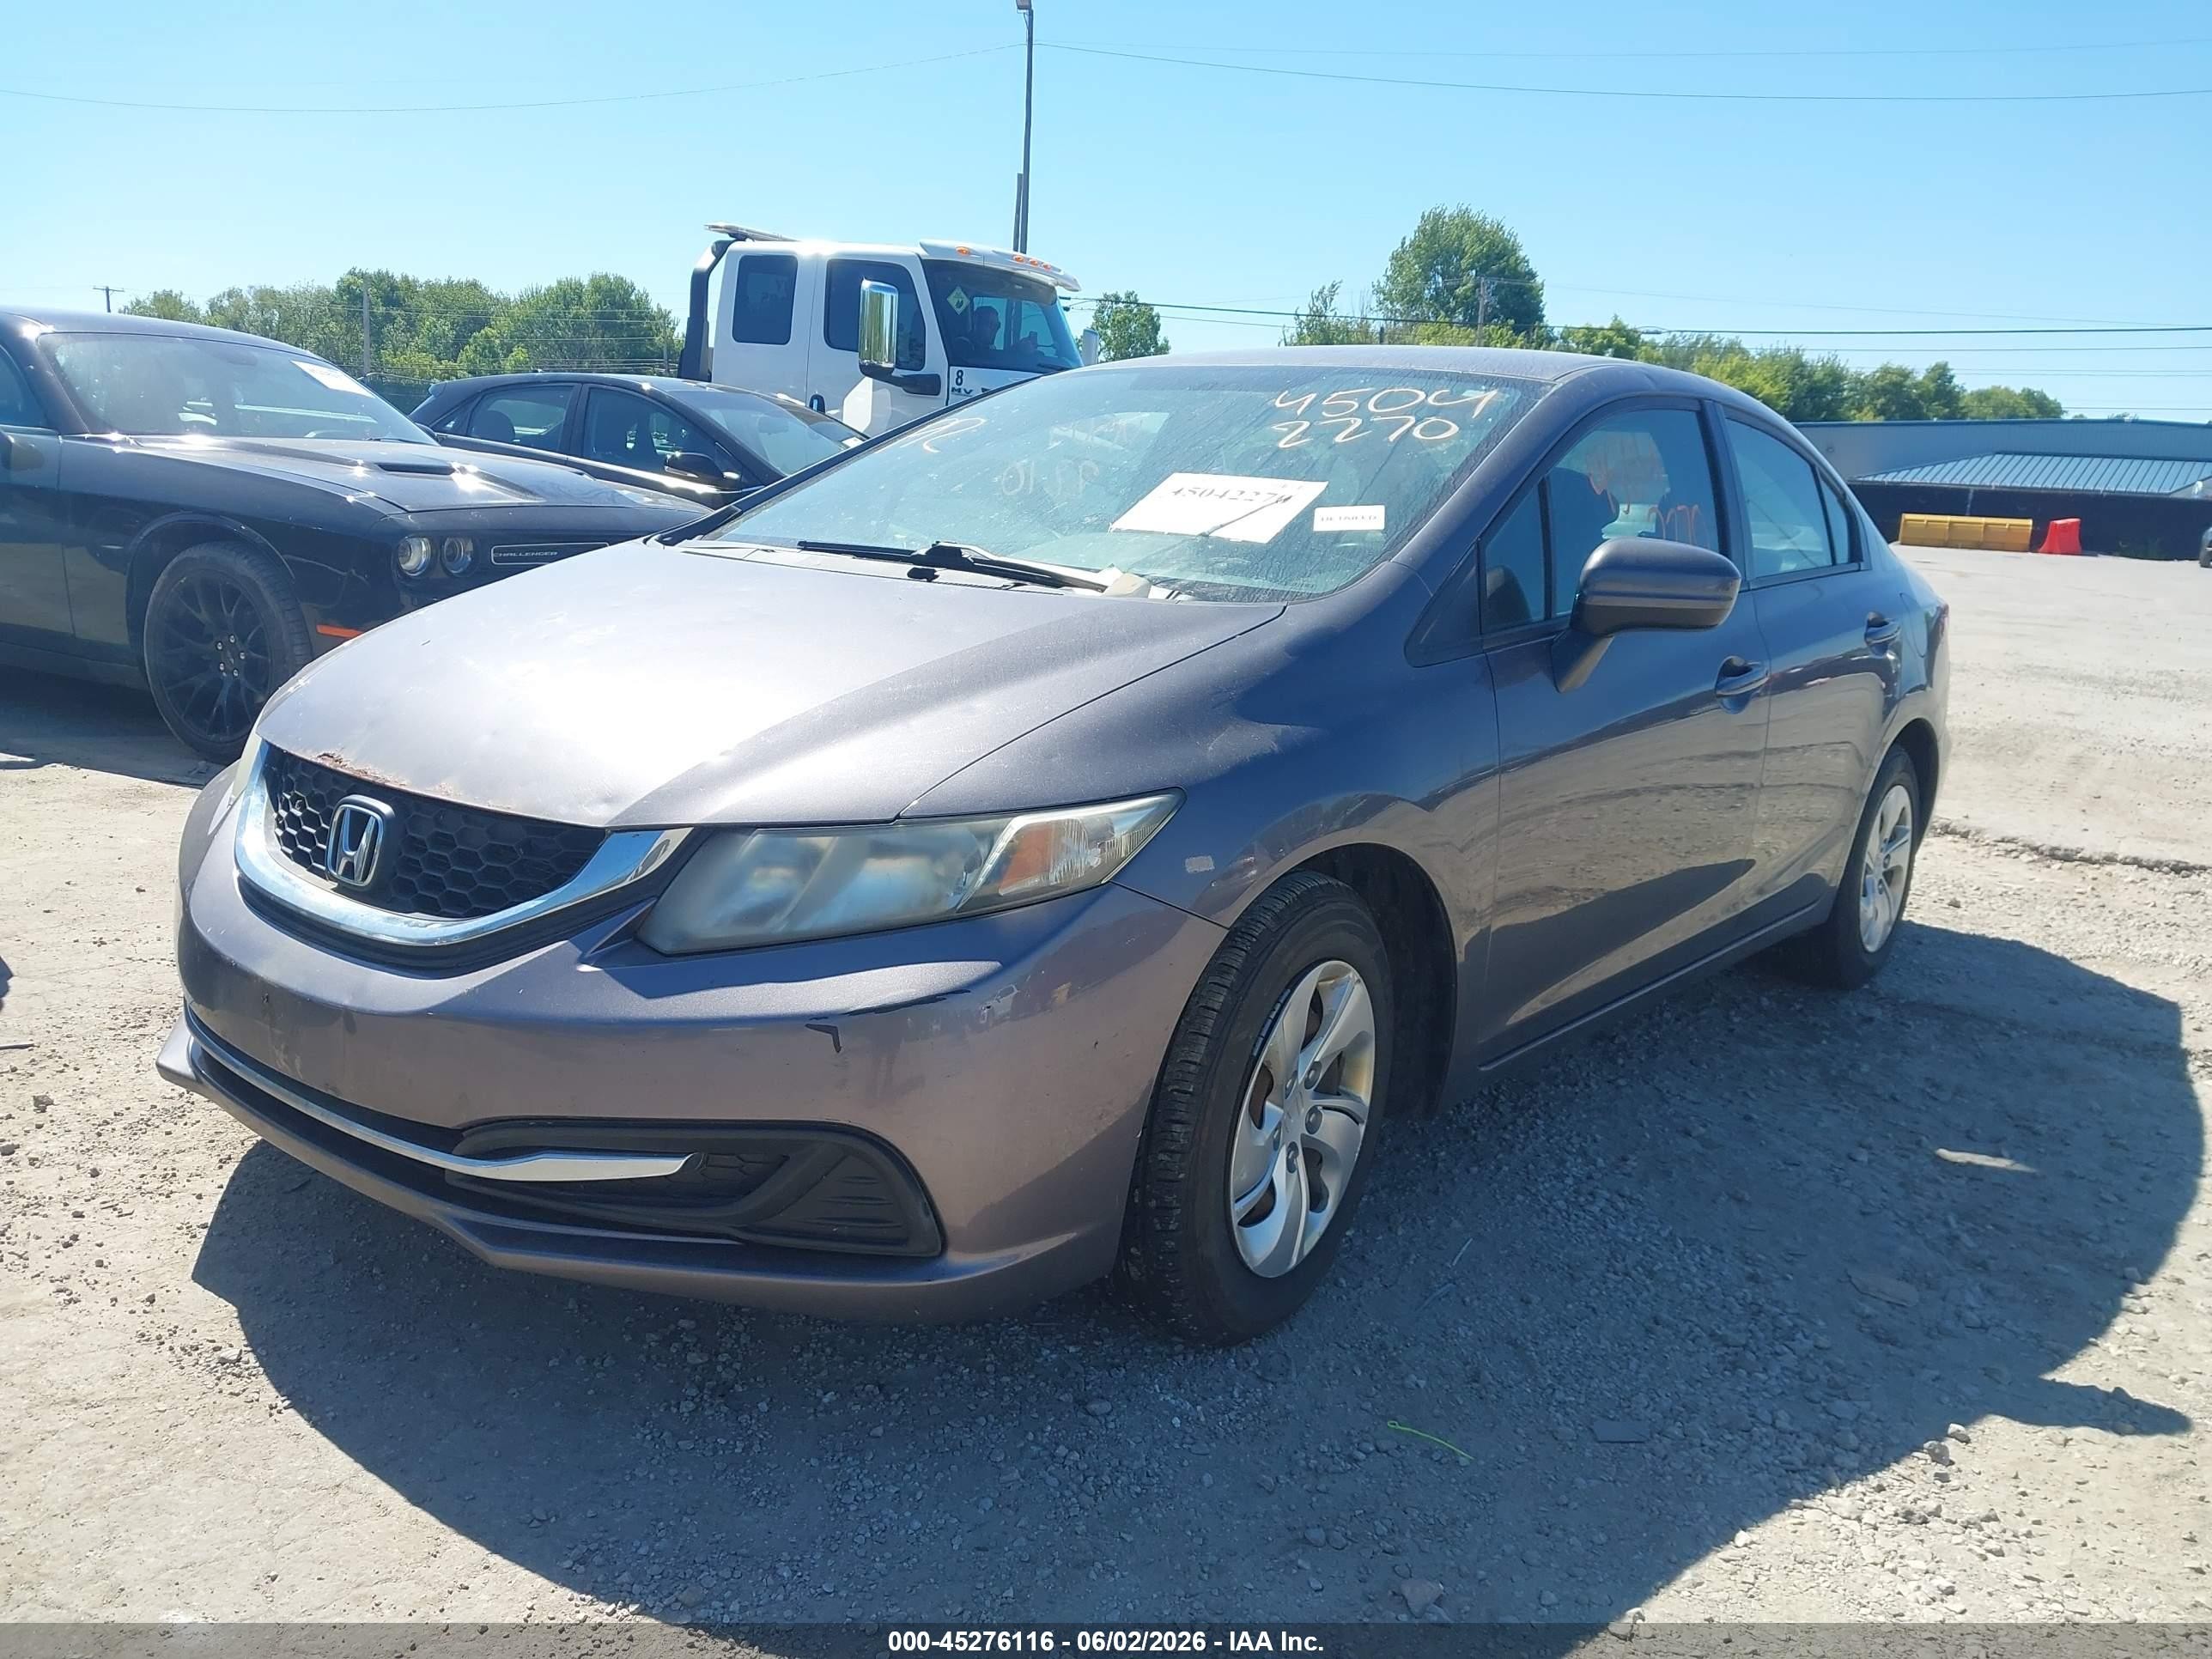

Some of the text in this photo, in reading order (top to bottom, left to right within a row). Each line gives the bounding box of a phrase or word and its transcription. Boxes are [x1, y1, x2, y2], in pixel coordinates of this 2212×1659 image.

[955, 369, 964, 386] 8
[1274, 386, 1498, 419] 4504
[1271, 415, 1460, 449] 2270
